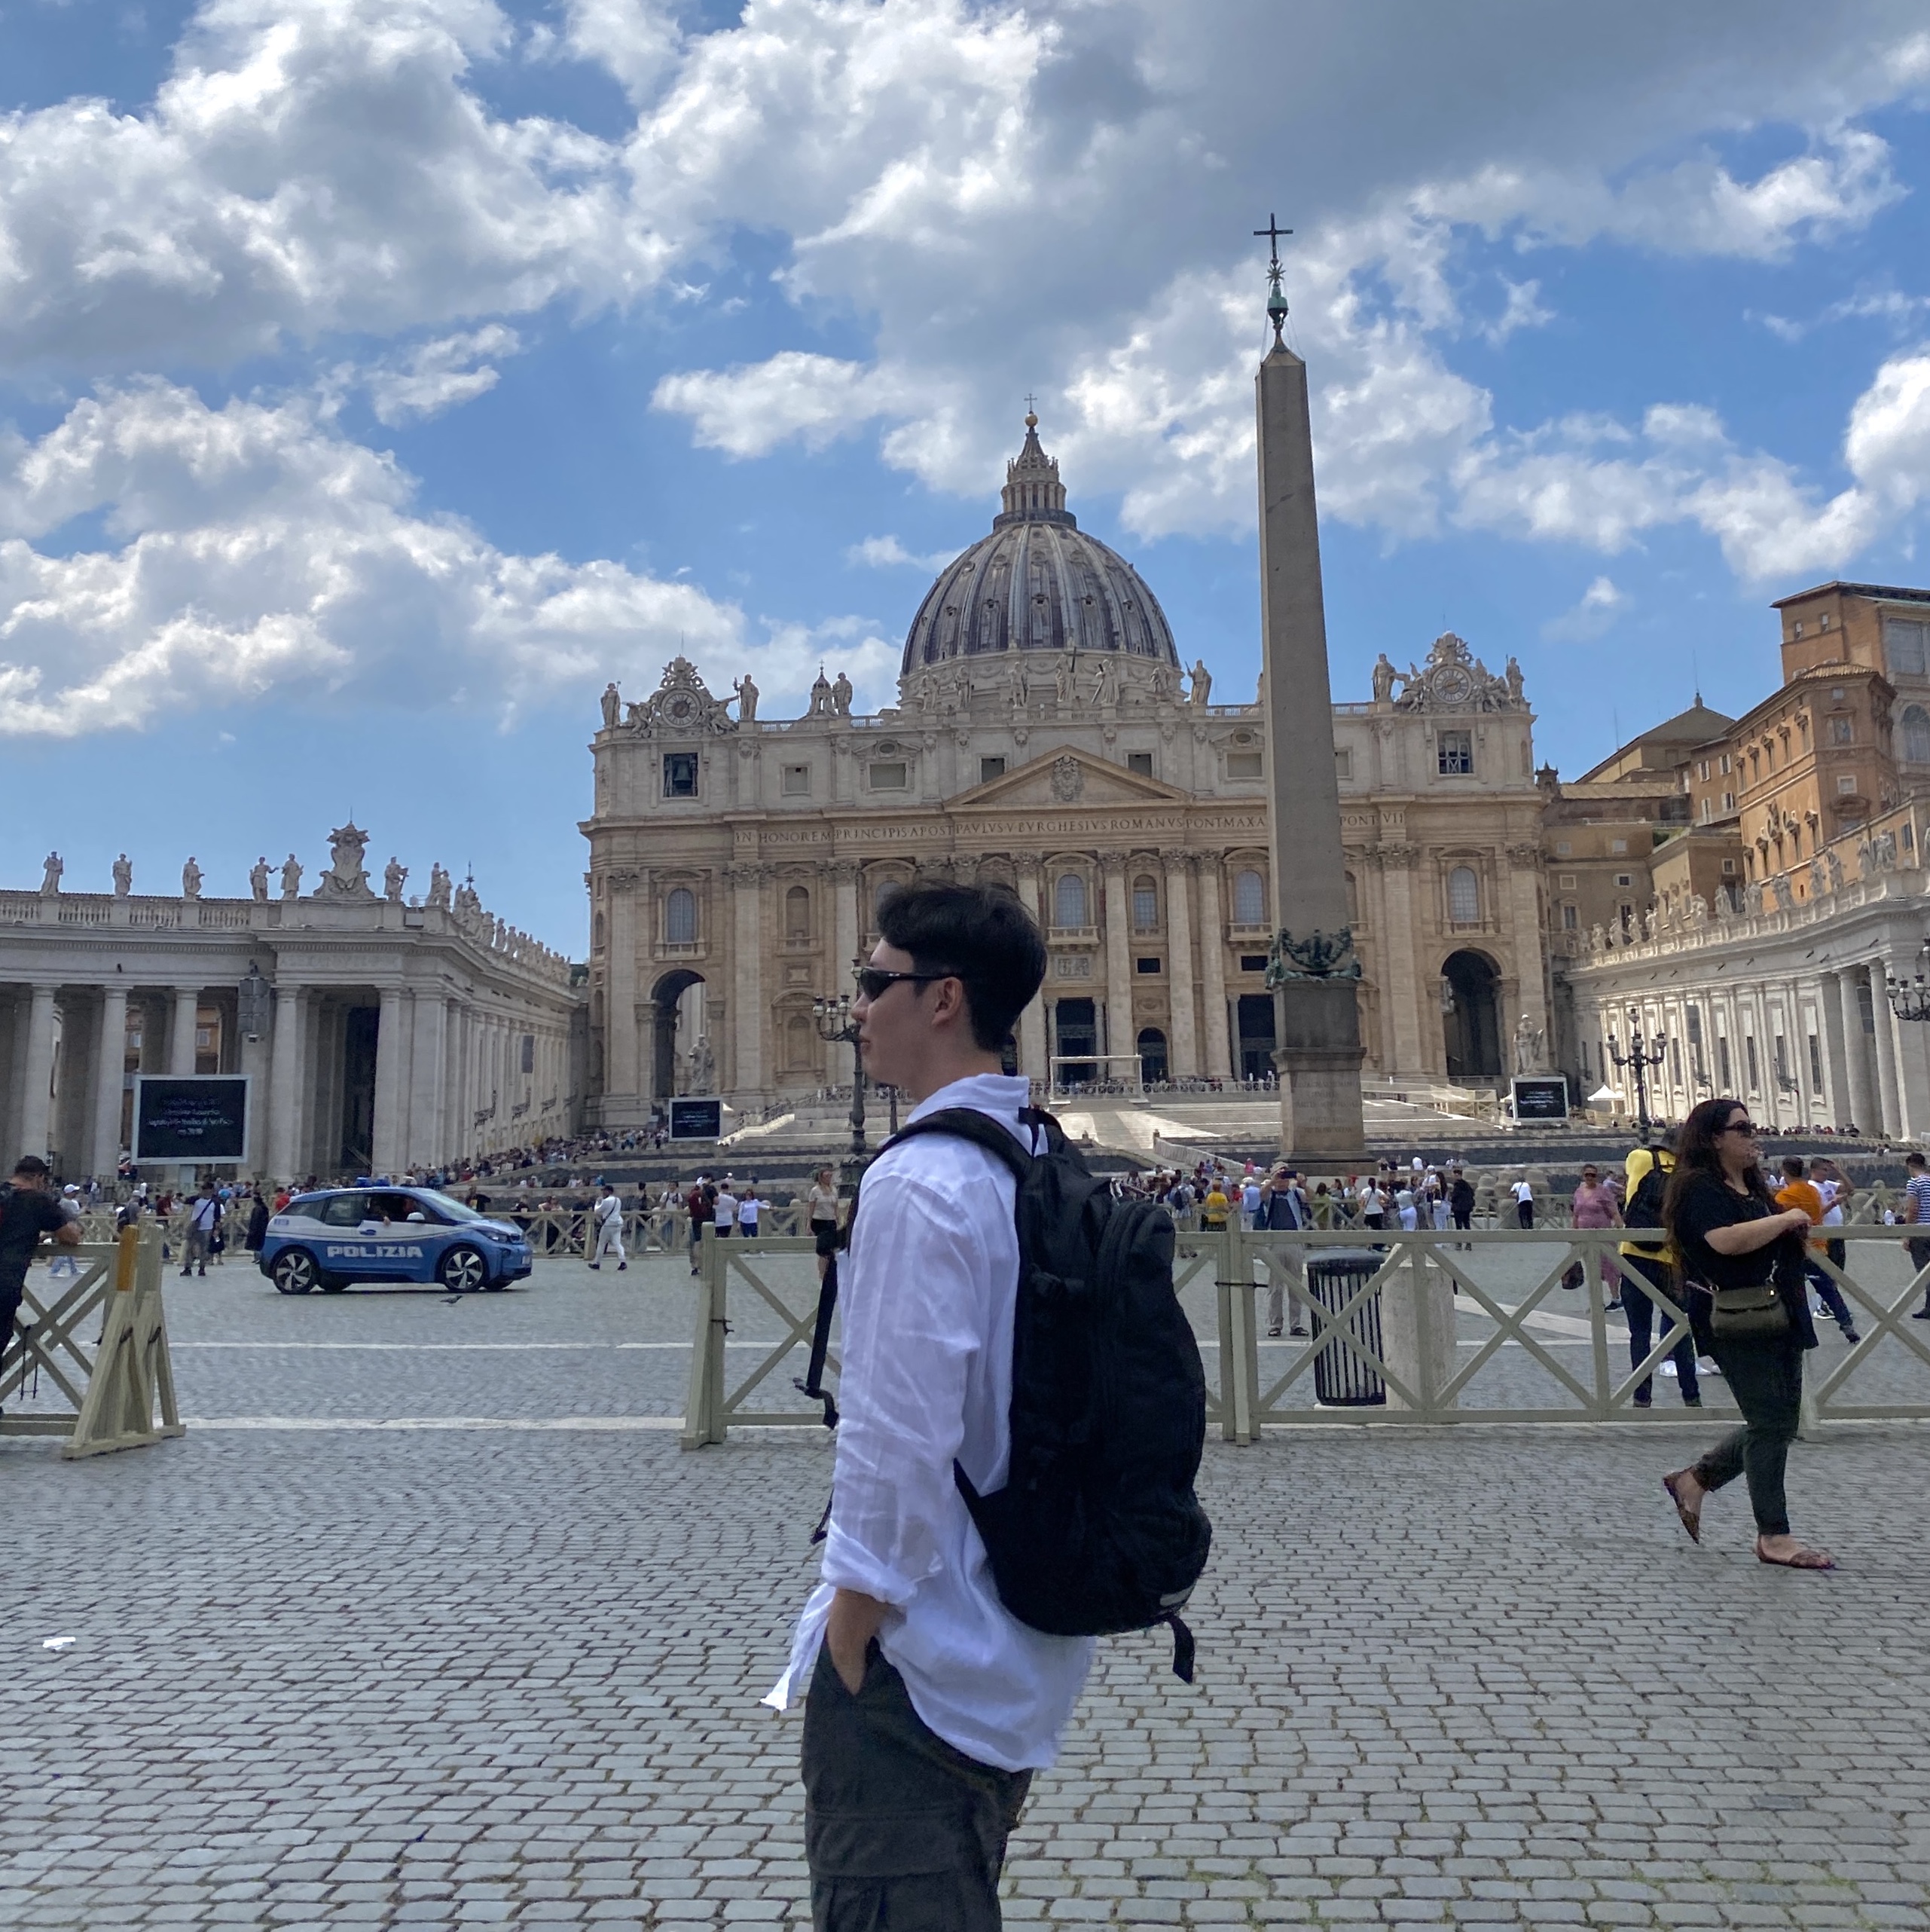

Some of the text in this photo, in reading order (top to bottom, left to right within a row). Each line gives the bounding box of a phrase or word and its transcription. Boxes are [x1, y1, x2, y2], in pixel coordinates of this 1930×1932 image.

[735, 831, 752, 843] IN
[759, 831, 831, 843] HONOREM
[835, 827, 907, 839] PRINCIPIS
[909, 825, 954, 837] APOST
[956, 822, 1003, 834] PAVLVS
[1018, 820, 1107, 833] BVRGHESIVS
[1110, 818, 1183, 830] ROMANVS
[1339, 815, 1377, 826] PONT
[1382, 813, 1404, 824] VII
[327, 1246, 423, 1258] POLIZIA
